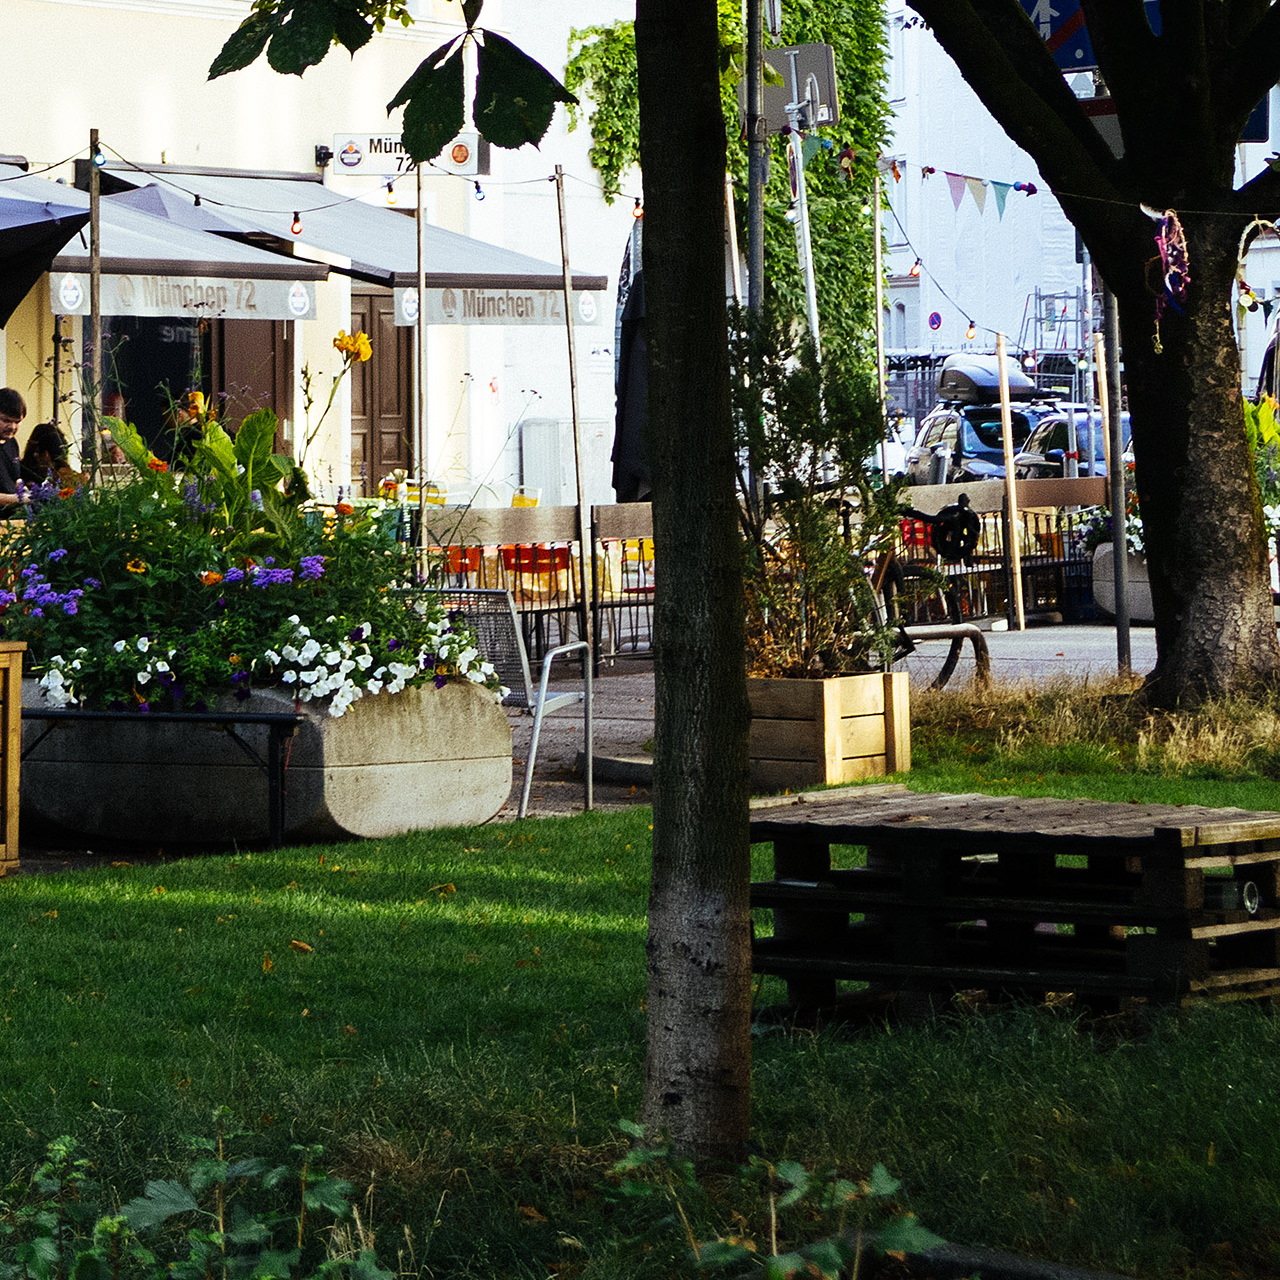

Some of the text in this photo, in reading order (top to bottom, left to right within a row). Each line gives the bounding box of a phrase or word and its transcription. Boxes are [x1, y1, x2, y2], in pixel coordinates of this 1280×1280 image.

[142, 276, 257, 311] München 72
[462, 289, 561, 318] München 72
